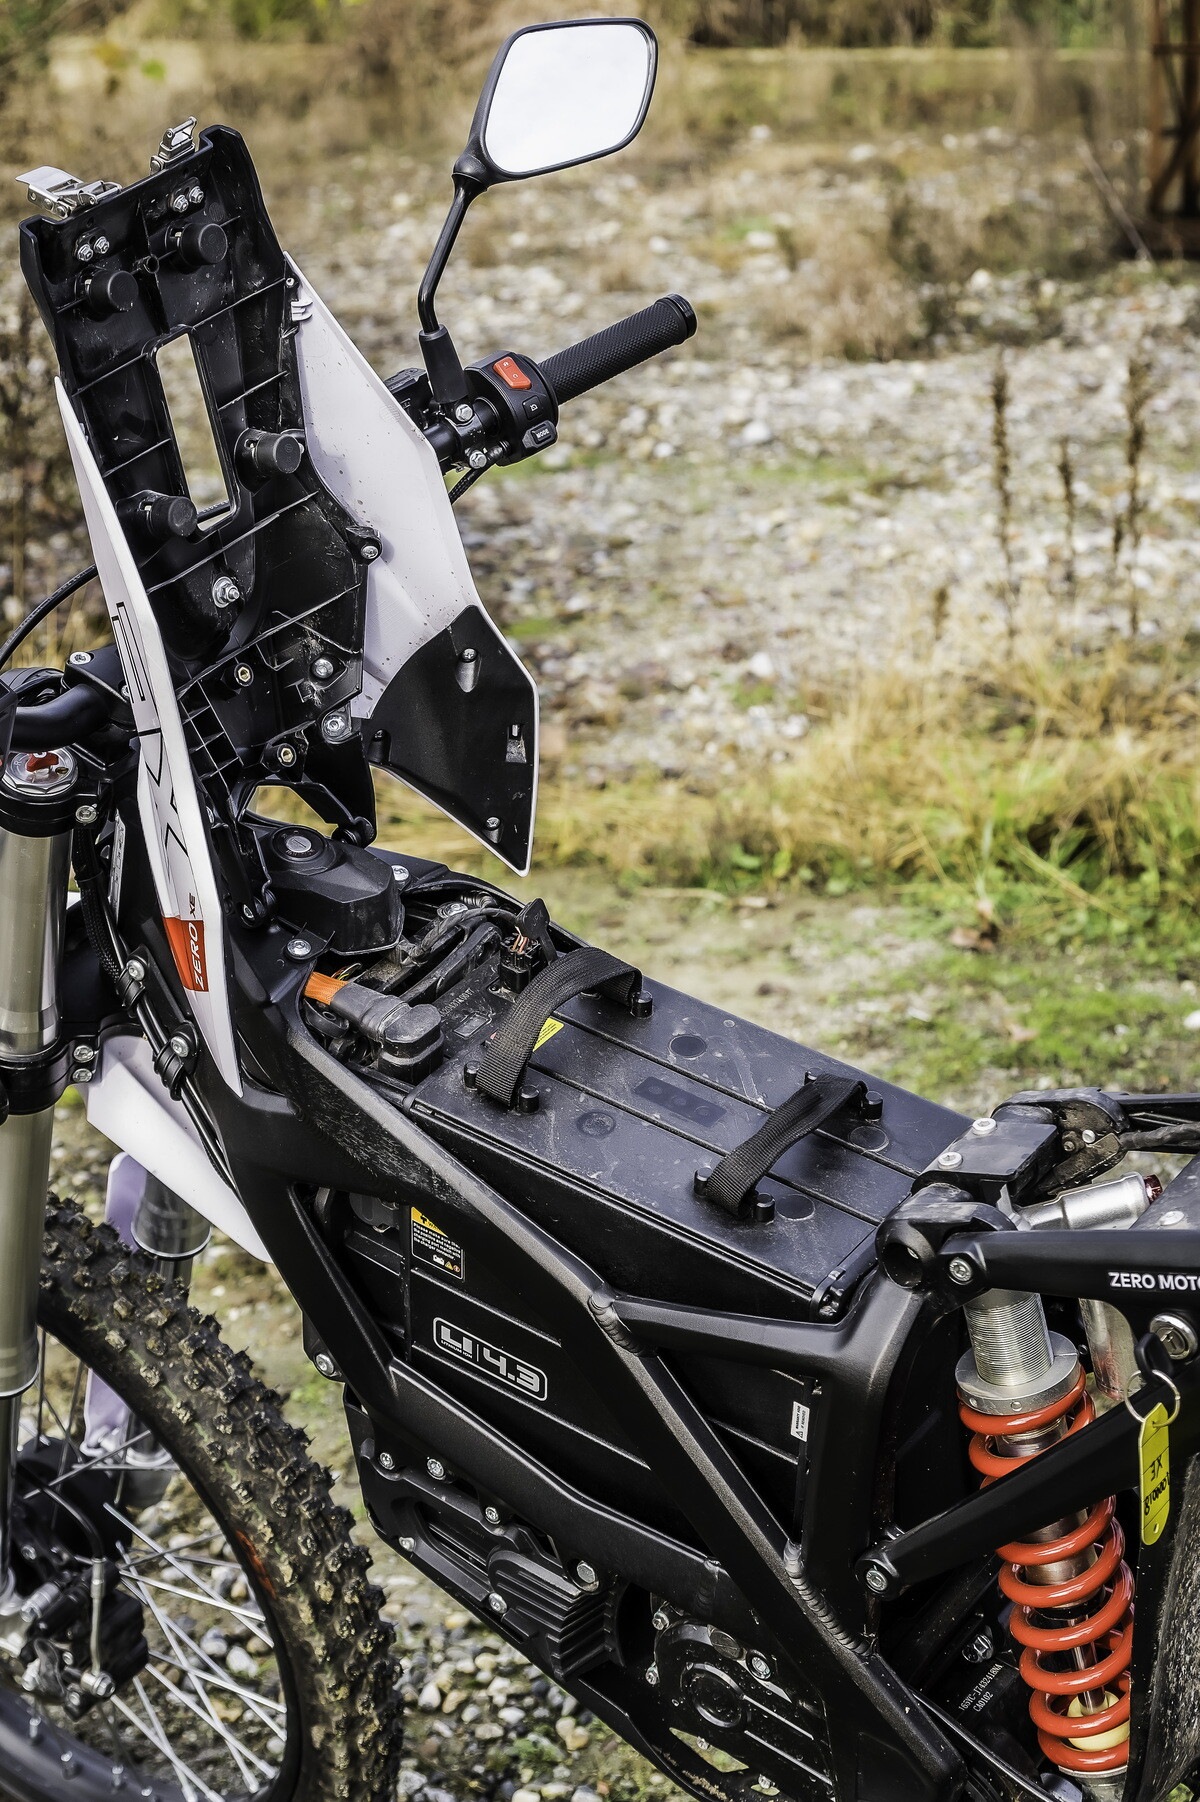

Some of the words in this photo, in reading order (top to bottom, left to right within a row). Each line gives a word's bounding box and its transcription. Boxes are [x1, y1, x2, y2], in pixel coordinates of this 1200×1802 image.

[536, 428, 550, 438] MODE
[188, 892, 196, 919] XE
[188, 922, 205, 991] ZERO
[1108, 1271, 1156, 1289] ZERO
[1158, 1274, 1200, 1291] MOT
[441, 1325, 472, 1355] LI
[483, 1347, 540, 1393] 4.3
[463, 1351, 473, 1359] ION
